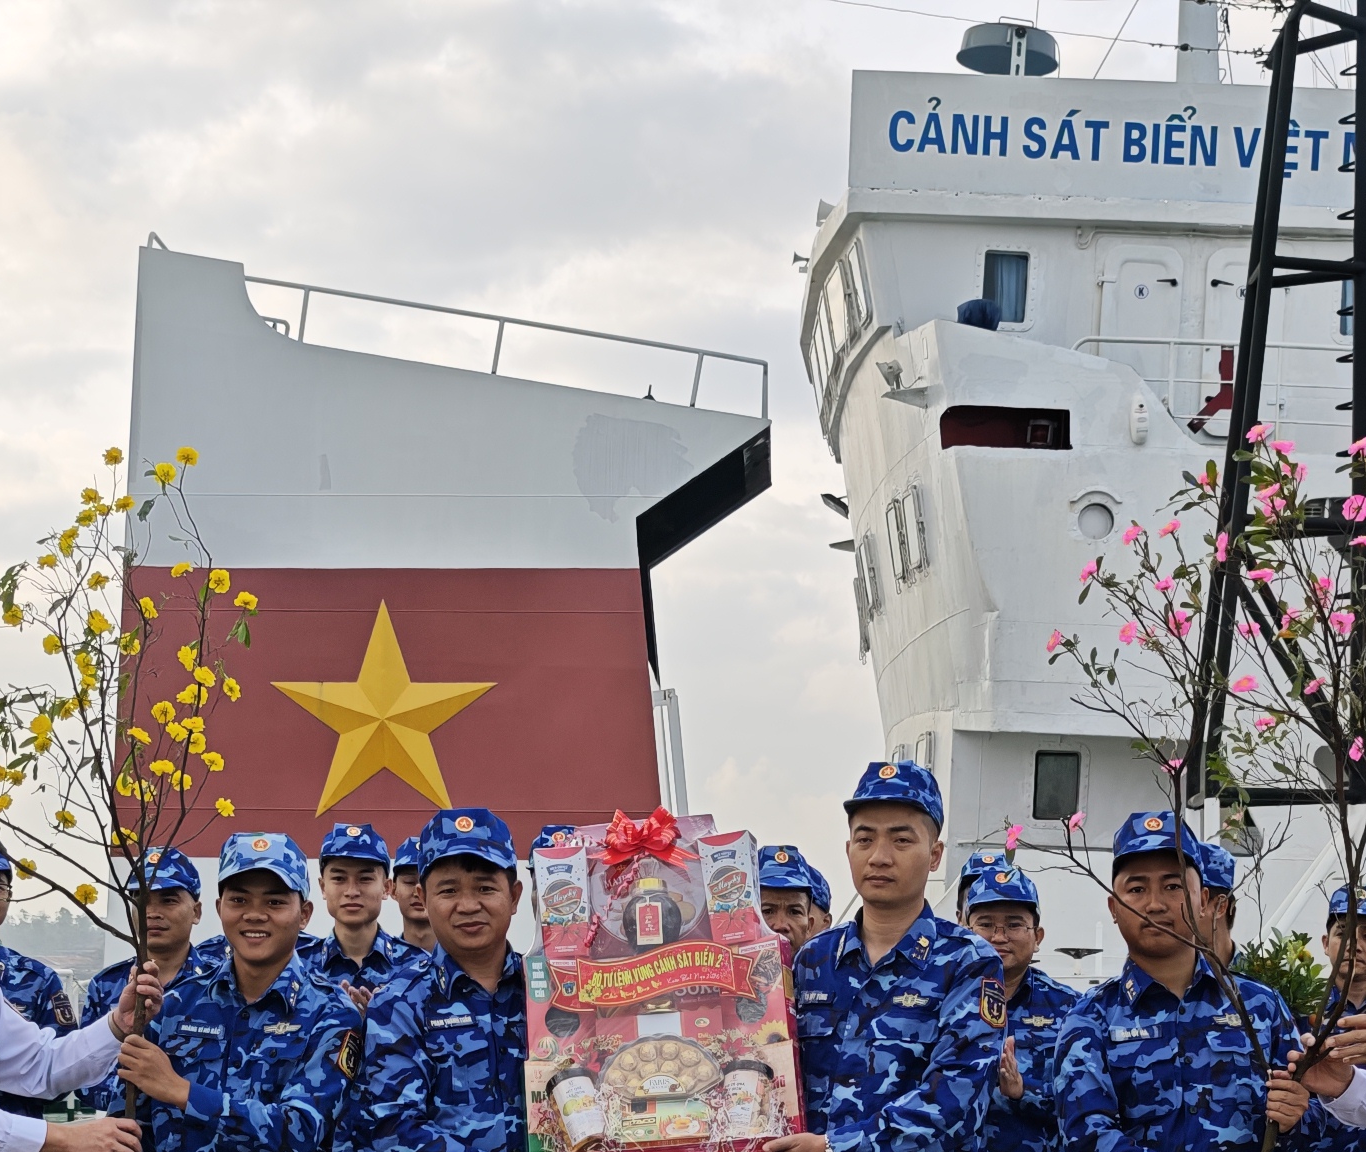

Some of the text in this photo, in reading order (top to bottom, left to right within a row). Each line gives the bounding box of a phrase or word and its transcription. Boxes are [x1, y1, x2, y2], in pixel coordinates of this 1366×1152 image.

[888, 96, 1009, 157] CẢNH
[1022, 108, 1110, 162] SÁT
[1122, 105, 1218, 167] BIỂN
[1233, 119, 1330, 178] VỆT
[632, 964, 655, 983] VÙNG
[654, 955, 677, 975] CẢNH
[677, 949, 693, 969] SÁT
[695, 946, 714, 967] BIỂN
[715, 953, 723, 968] 2
